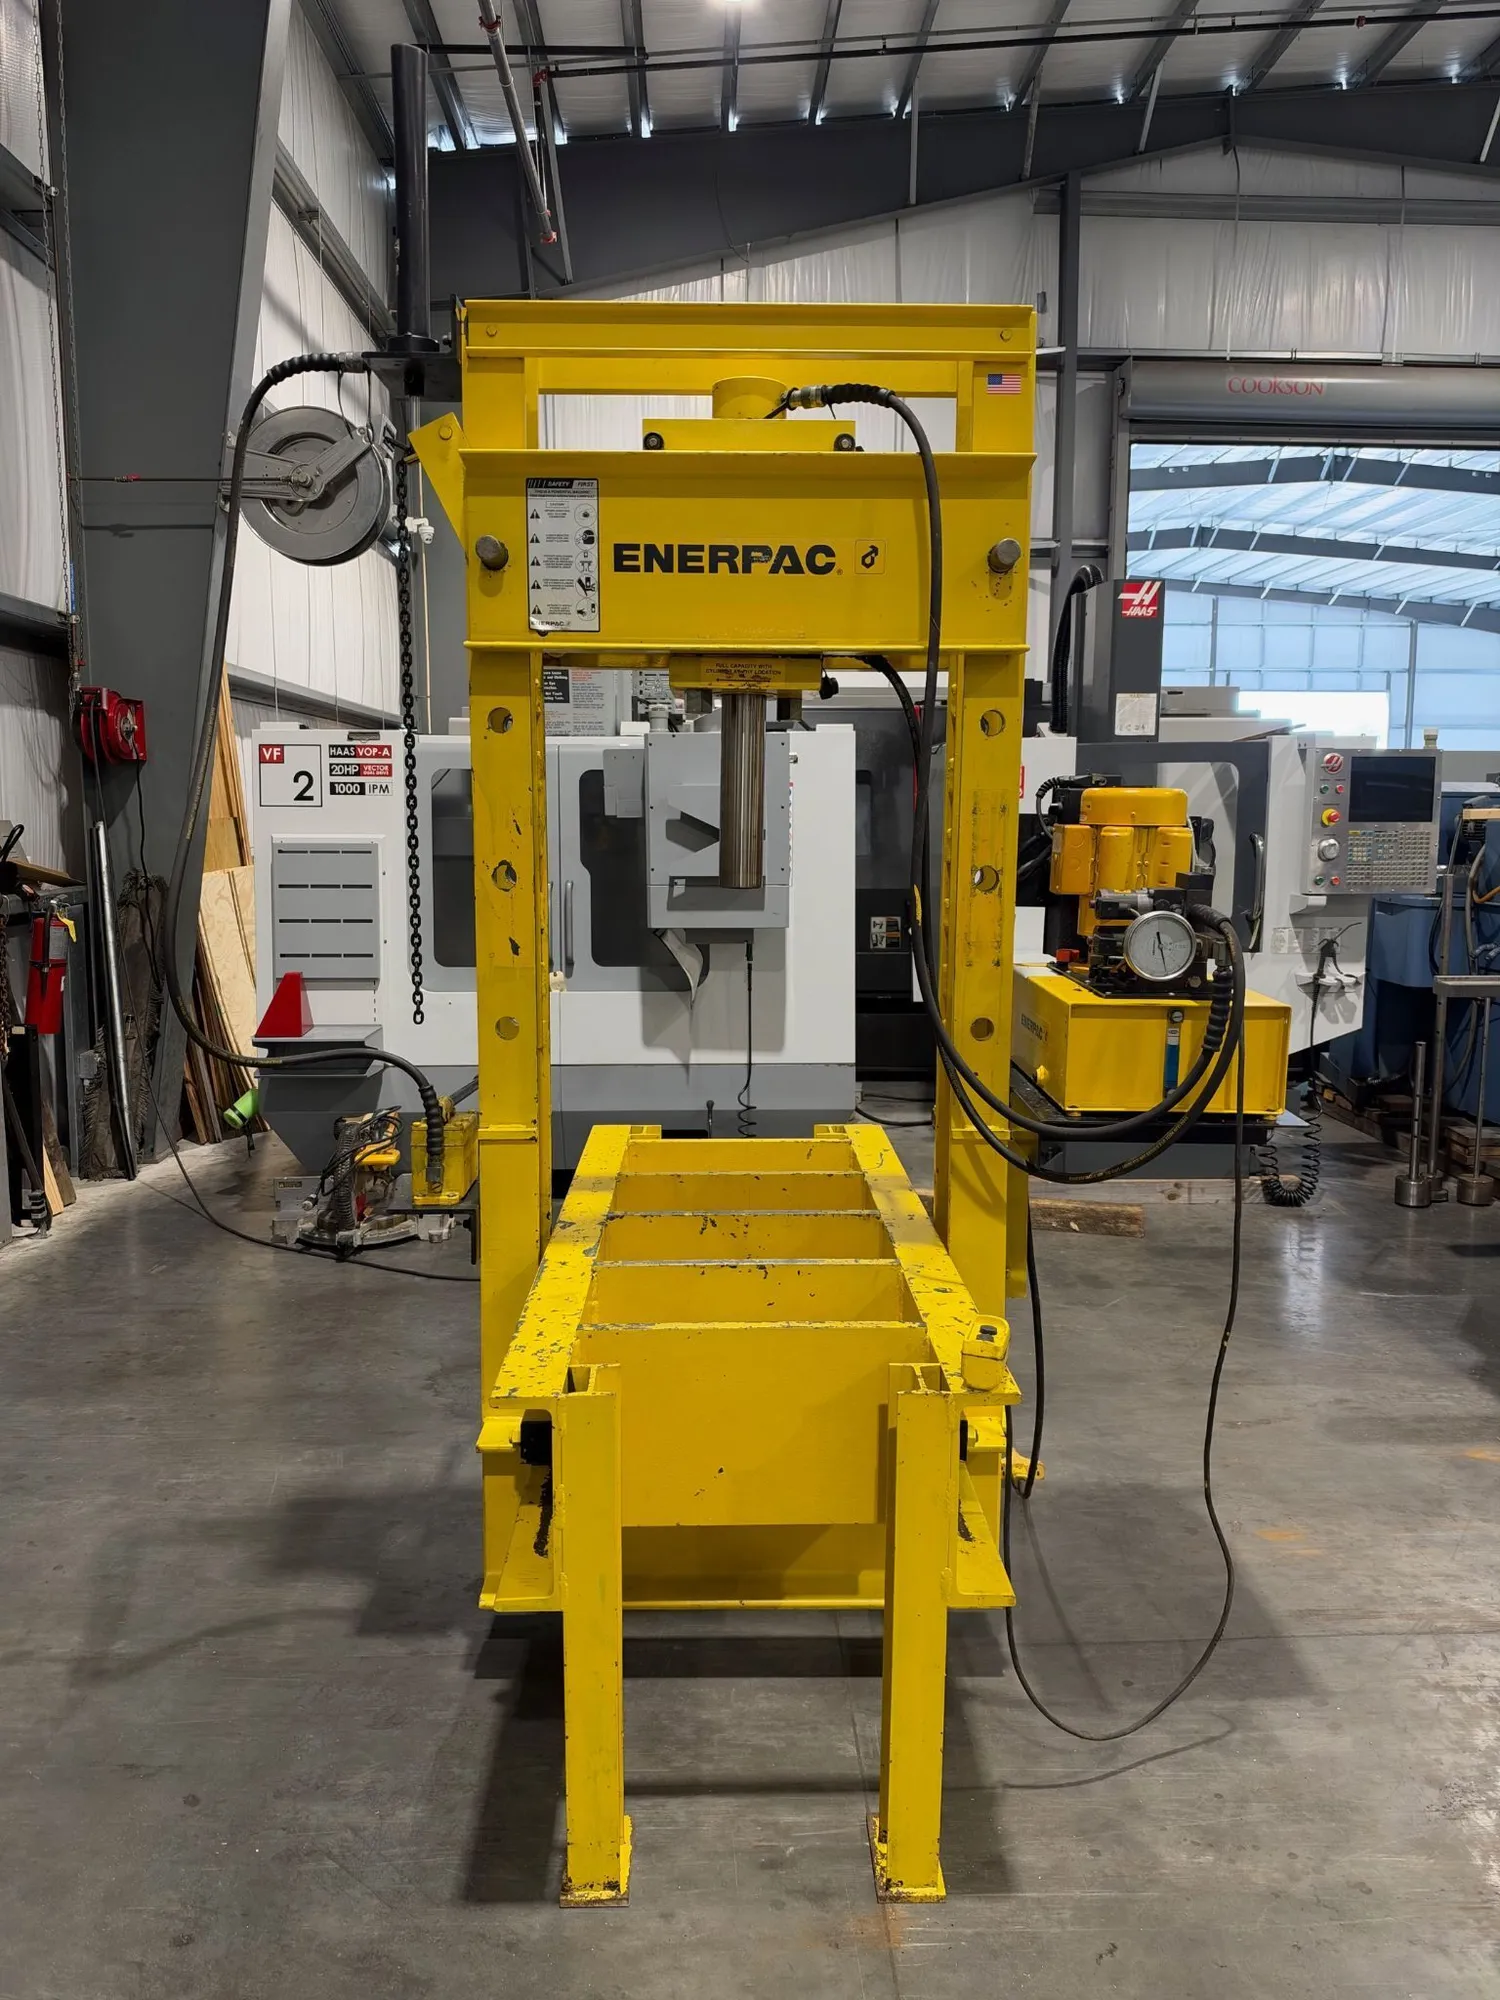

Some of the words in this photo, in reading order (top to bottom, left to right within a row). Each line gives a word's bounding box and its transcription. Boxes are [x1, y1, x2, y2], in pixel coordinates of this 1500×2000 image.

[1227, 376, 1324, 396] COOKSON
[613, 543, 836, 576] ENERPAC
[1122, 606, 1158, 617] HAAS
[262, 747, 281, 760] VF
[329, 747, 356, 756] HAAS
[357, 747, 390, 757] VOP-A
[331, 764, 359, 775] 20HP
[293, 770, 314, 801] 2
[334, 783, 360, 794] 1000
[368, 783, 390, 794] IPM
